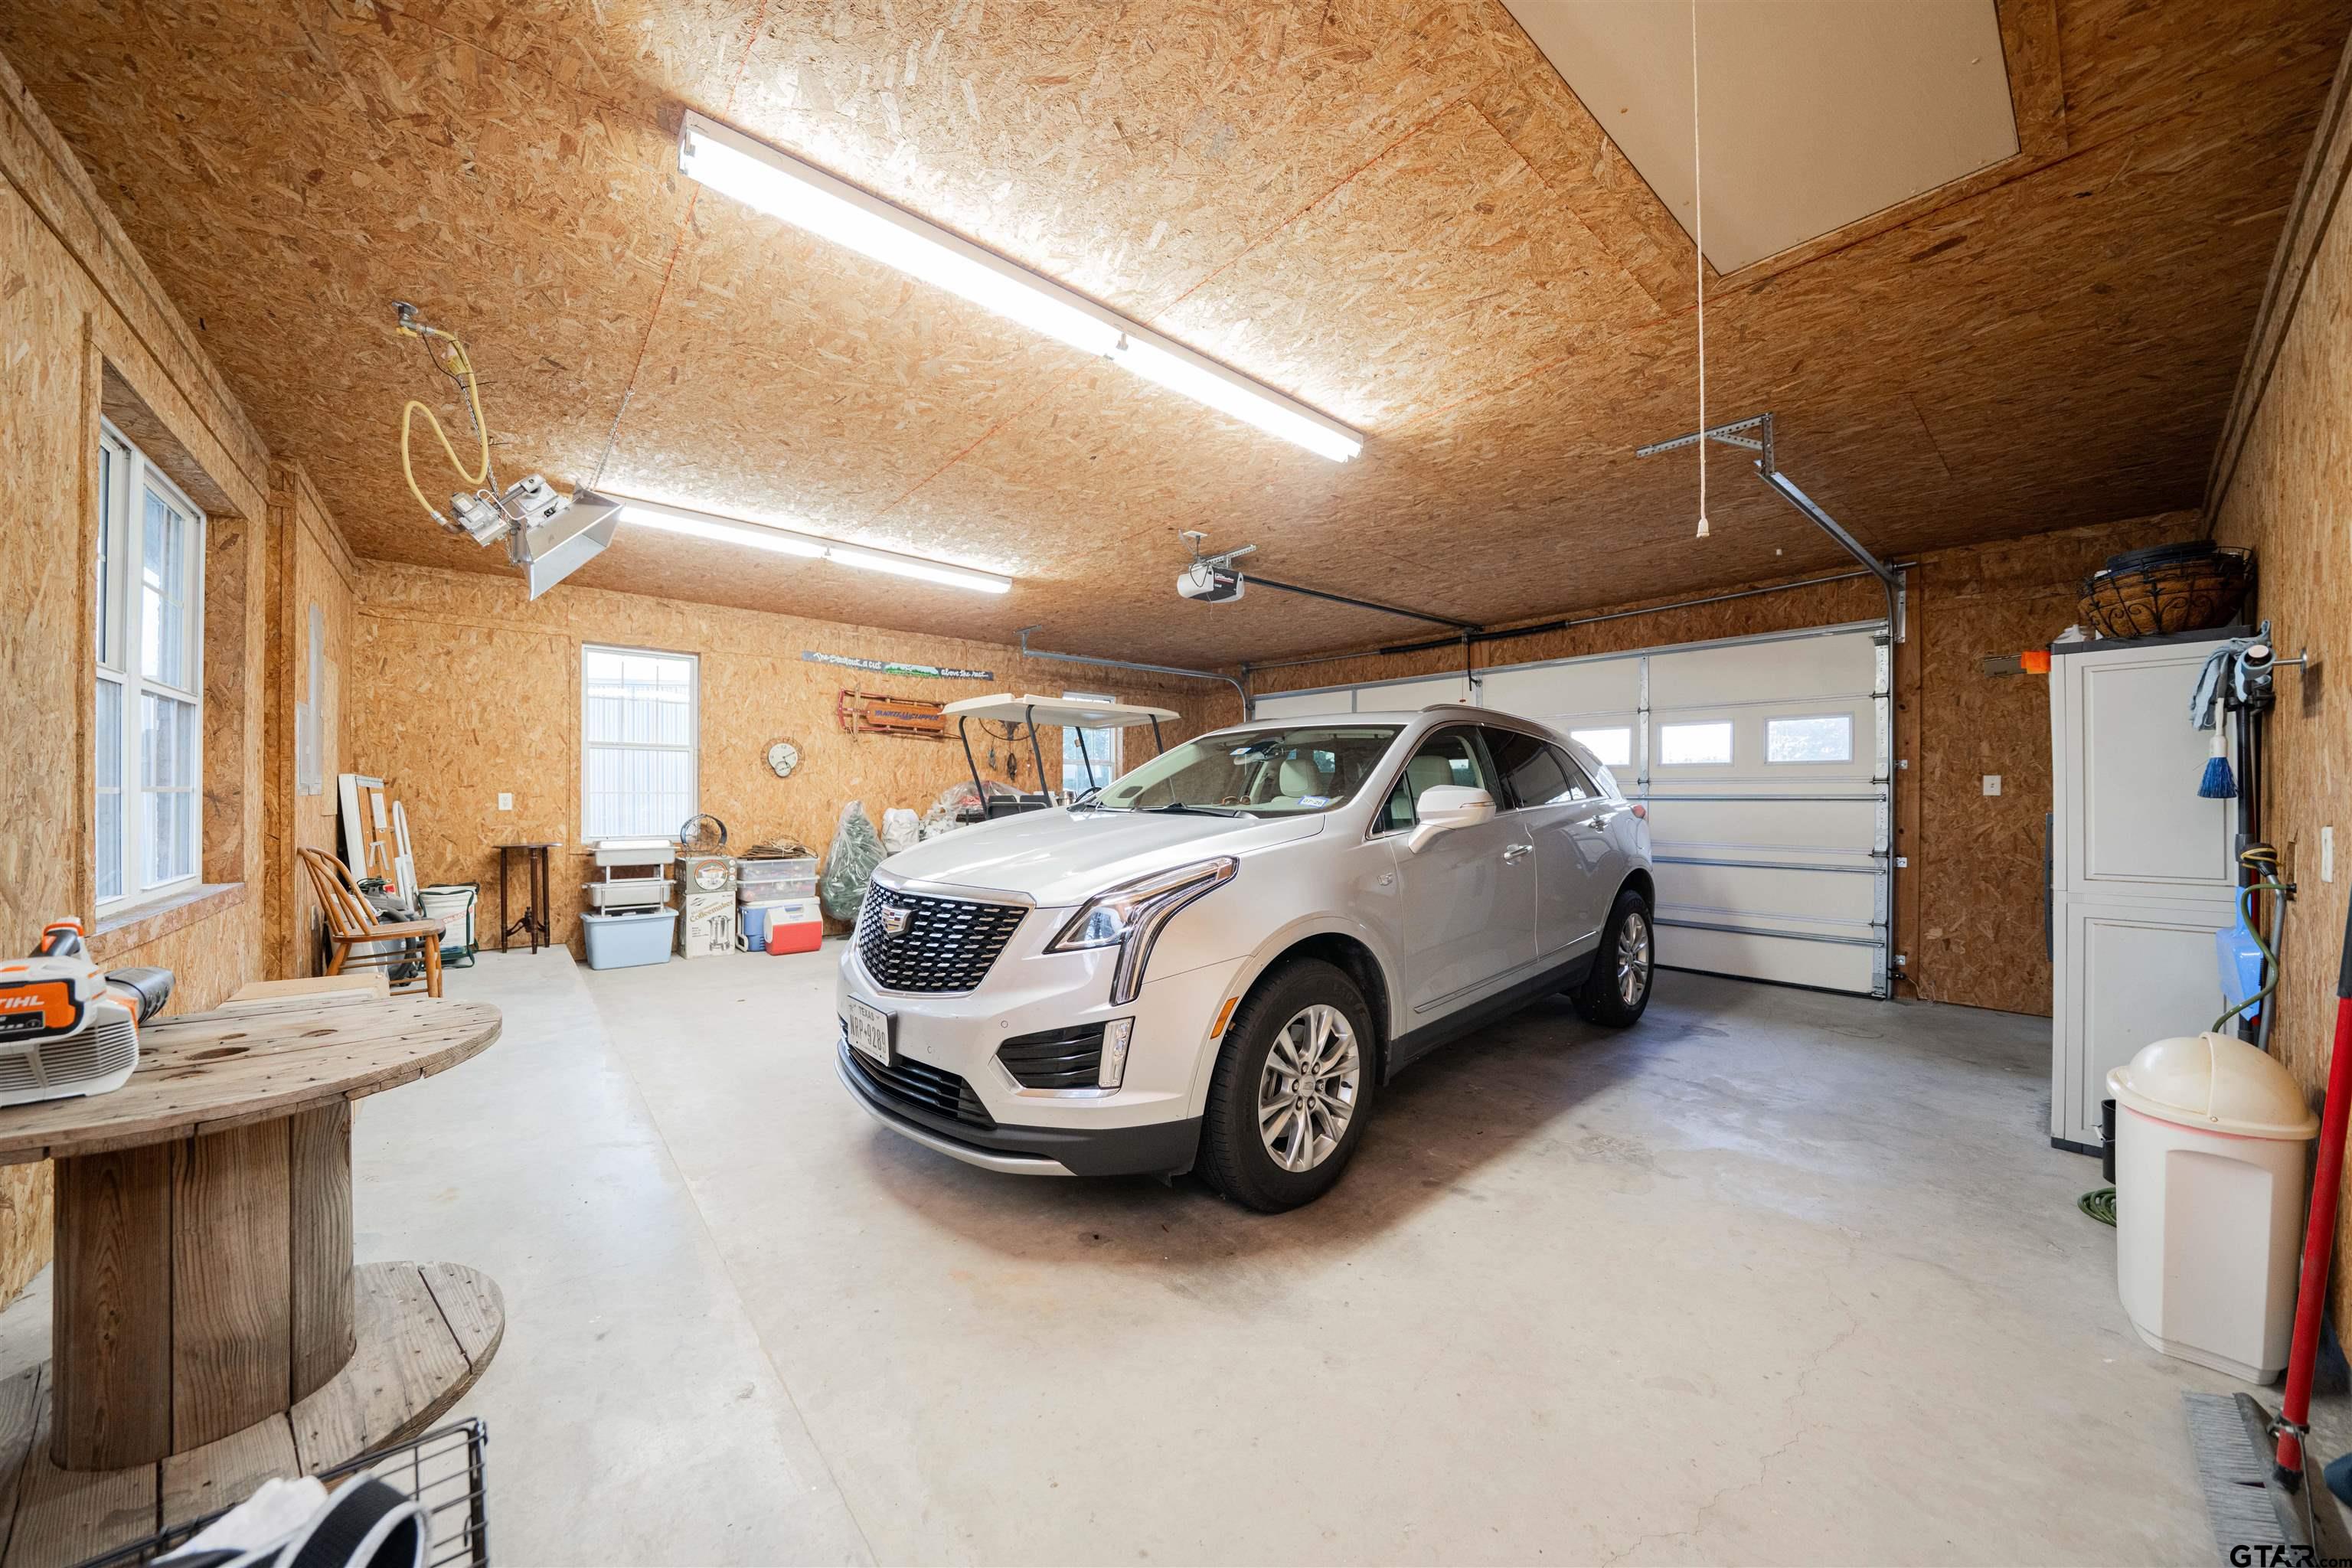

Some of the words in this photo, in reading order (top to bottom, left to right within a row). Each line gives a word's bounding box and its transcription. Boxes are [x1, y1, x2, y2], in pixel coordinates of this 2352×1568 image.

[868, 661, 882, 669] cut
[941, 668, 959, 677] above
[959, 669, 971, 678] the
[910, 713, 940, 721] CLIPPER
[690, 900, 733, 922] Coffeemaker
[858, 1006, 874, 1021] TEXAS
